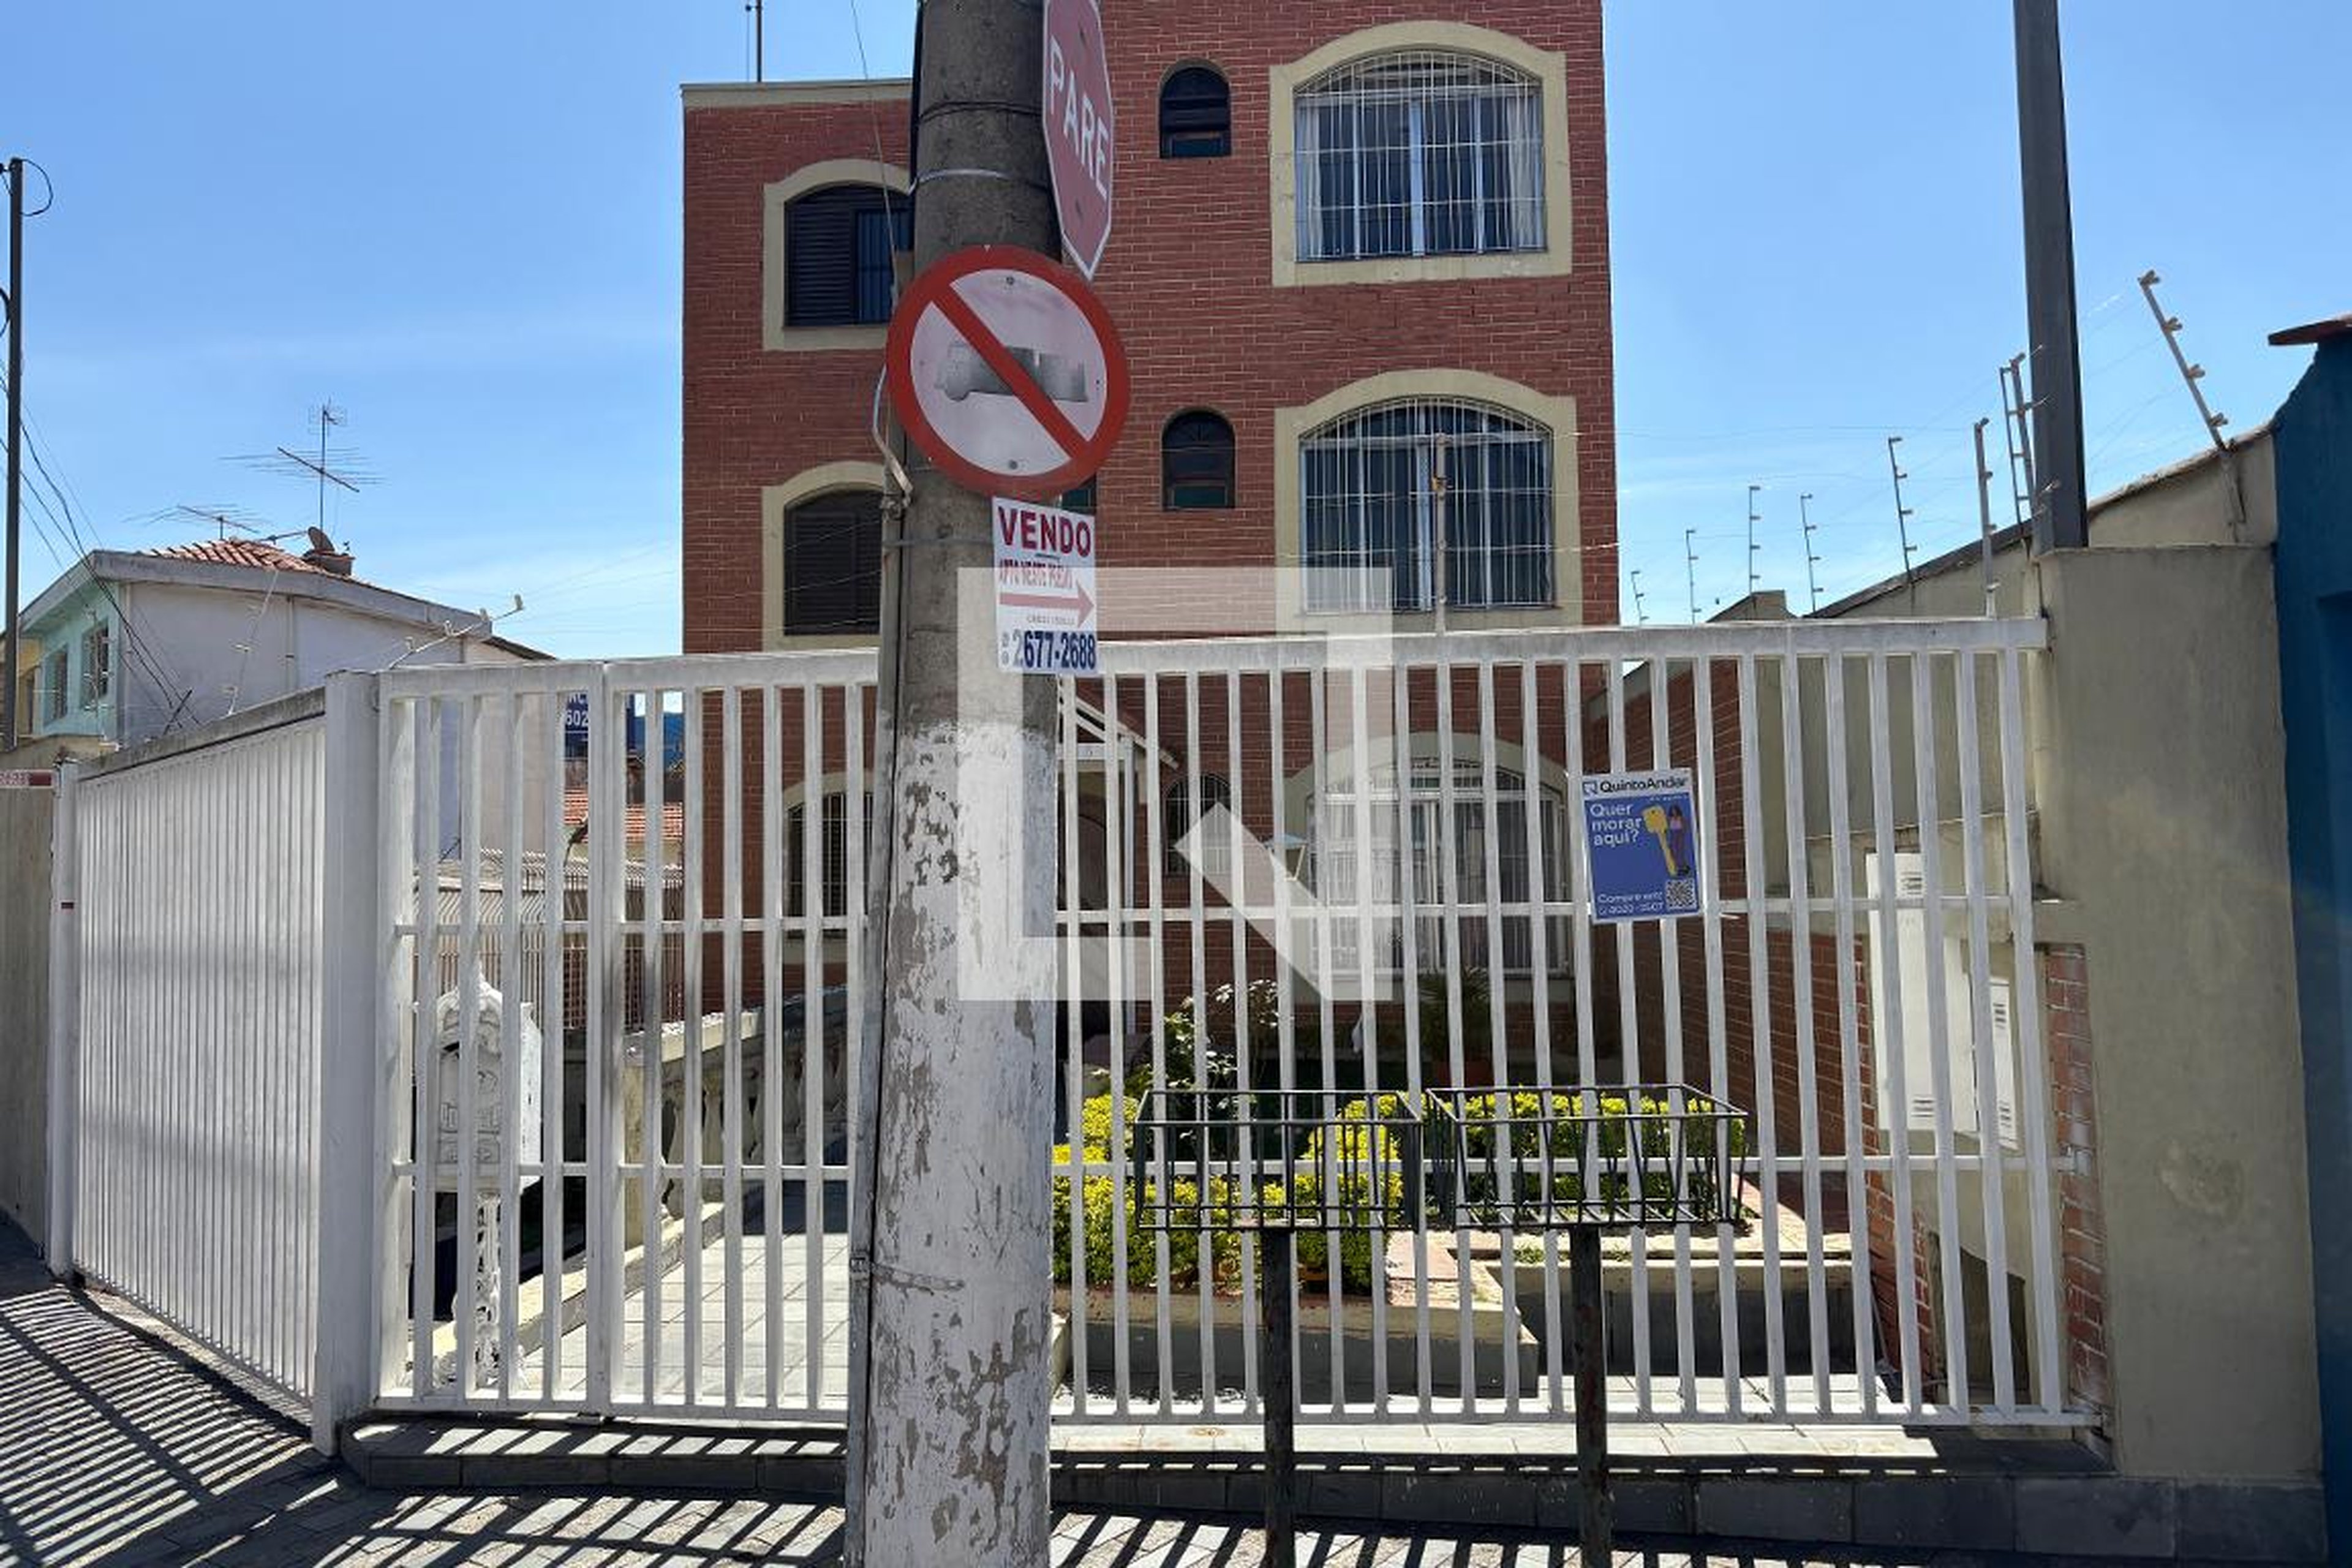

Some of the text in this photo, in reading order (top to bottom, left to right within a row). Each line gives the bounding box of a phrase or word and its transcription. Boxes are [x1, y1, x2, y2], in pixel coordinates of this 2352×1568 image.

[1050, 34, 1109, 201] PARE
[998, 506, 1091, 558] VENDO
[1600, 775, 1689, 793] QuintoAndar
[1591, 803, 1634, 818] Quer
[1592, 817, 1642, 832] morar
[1594, 828, 1640, 848] aqui?
